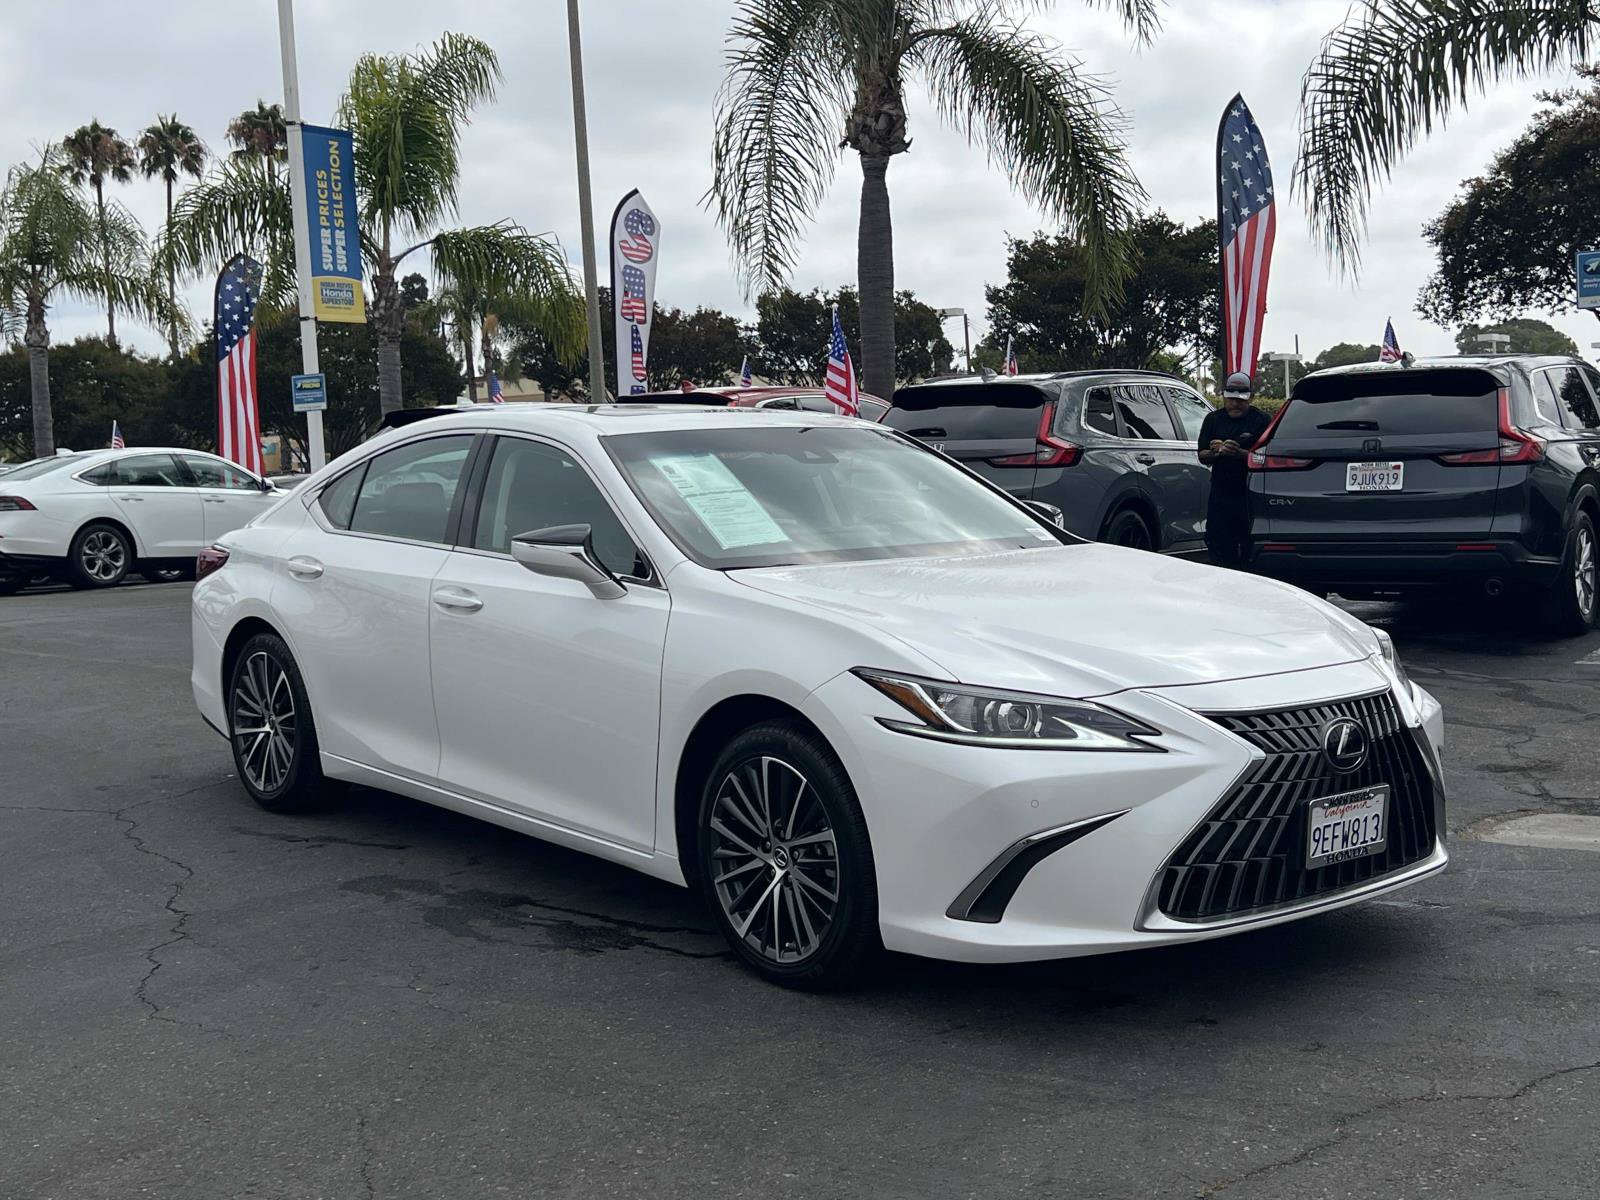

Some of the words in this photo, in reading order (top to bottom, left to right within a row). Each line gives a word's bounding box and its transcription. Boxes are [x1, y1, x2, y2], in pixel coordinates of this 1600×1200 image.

[316, 169, 330, 227] PRICES
[328, 140, 345, 228] SELECTION
[320, 228, 333, 272] SUPER
[335, 229, 348, 273] SUPER
[322, 288, 353, 298] Honda
[1351, 472, 1399, 486] 9JUK919
[1269, 498, 1296, 506] CR-V
[1324, 800, 1372, 819] California
[1311, 813, 1380, 857] 9EFW813
[1326, 846, 1369, 864] HONDA
